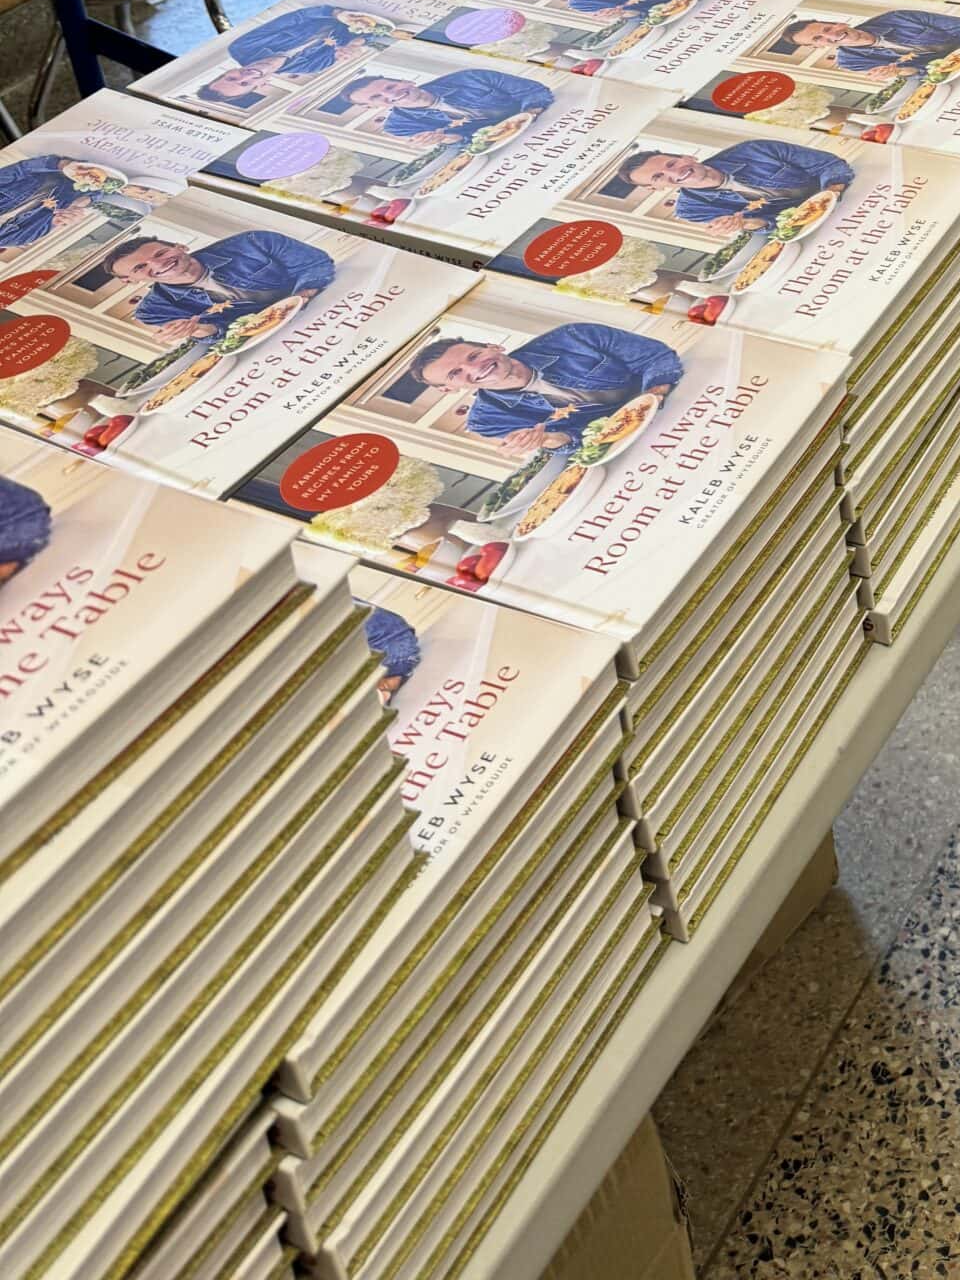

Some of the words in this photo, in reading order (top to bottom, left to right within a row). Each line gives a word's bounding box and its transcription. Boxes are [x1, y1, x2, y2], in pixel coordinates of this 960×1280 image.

[643, 24, 700, 60] There's
[654, 42, 704, 74] Room
[698, 30, 718, 42] at
[712, 12, 741, 30] the
[456, 152, 529, 200] There's
[523, 108, 584, 152] Always
[467, 175, 529, 220] Room
[524, 160, 549, 176] at
[544, 137, 576, 160] the
[567, 103, 621, 135] Table
[542, 162, 578, 191] KALEB
[576, 137, 608, 162] WYSE
[778, 239, 845, 296] There's
[836, 183, 893, 237] Always
[794, 268, 853, 318] Room
[846, 248, 870, 266] at
[859, 219, 894, 245] the
[880, 176, 929, 216] Table
[868, 250, 901, 282] KALEB
[898, 218, 927, 246] WYSE
[185, 354, 283, 422] There's
[280, 290, 365, 353] Always
[189, 390, 273, 450] Room
[271, 368, 302, 390] at
[299, 334, 343, 366] the
[336, 285, 406, 332] Table
[283, 372, 333, 411] KALEB
[334, 335, 378, 370] WYSE
[292, 442, 350, 490] FARMHOUSE
[301, 465, 341, 498] RECIPES
[340, 441, 368, 464] FROM
[316, 488, 333, 502] MY
[332, 460, 366, 488] FAMILY
[364, 447, 380, 459] TO
[346, 464, 380, 492] YOURS
[568, 462, 659, 544] There's
[650, 385, 726, 459] Always
[583, 505, 662, 576] Room
[656, 476, 686, 502] at
[676, 434, 720, 472] the
[705, 375, 769, 431] Table
[678, 478, 724, 526] KALEB
[720, 434, 759, 475] WYSE
[698, 494, 728, 530] CREATOR
[727, 482, 737, 493] OF
[736, 438, 774, 480] WYSEGUIDE
[0, 565, 94, 646] ways
[38, 552, 167, 641] Table
[26, 652, 110, 720] WYSE
[391, 678, 465, 757] ways
[435, 665, 521, 743] Table
[444, 750, 497, 807] WYSE
[448, 818, 462, 835] OF
[462, 756, 514, 817] WYSEGUIDE
